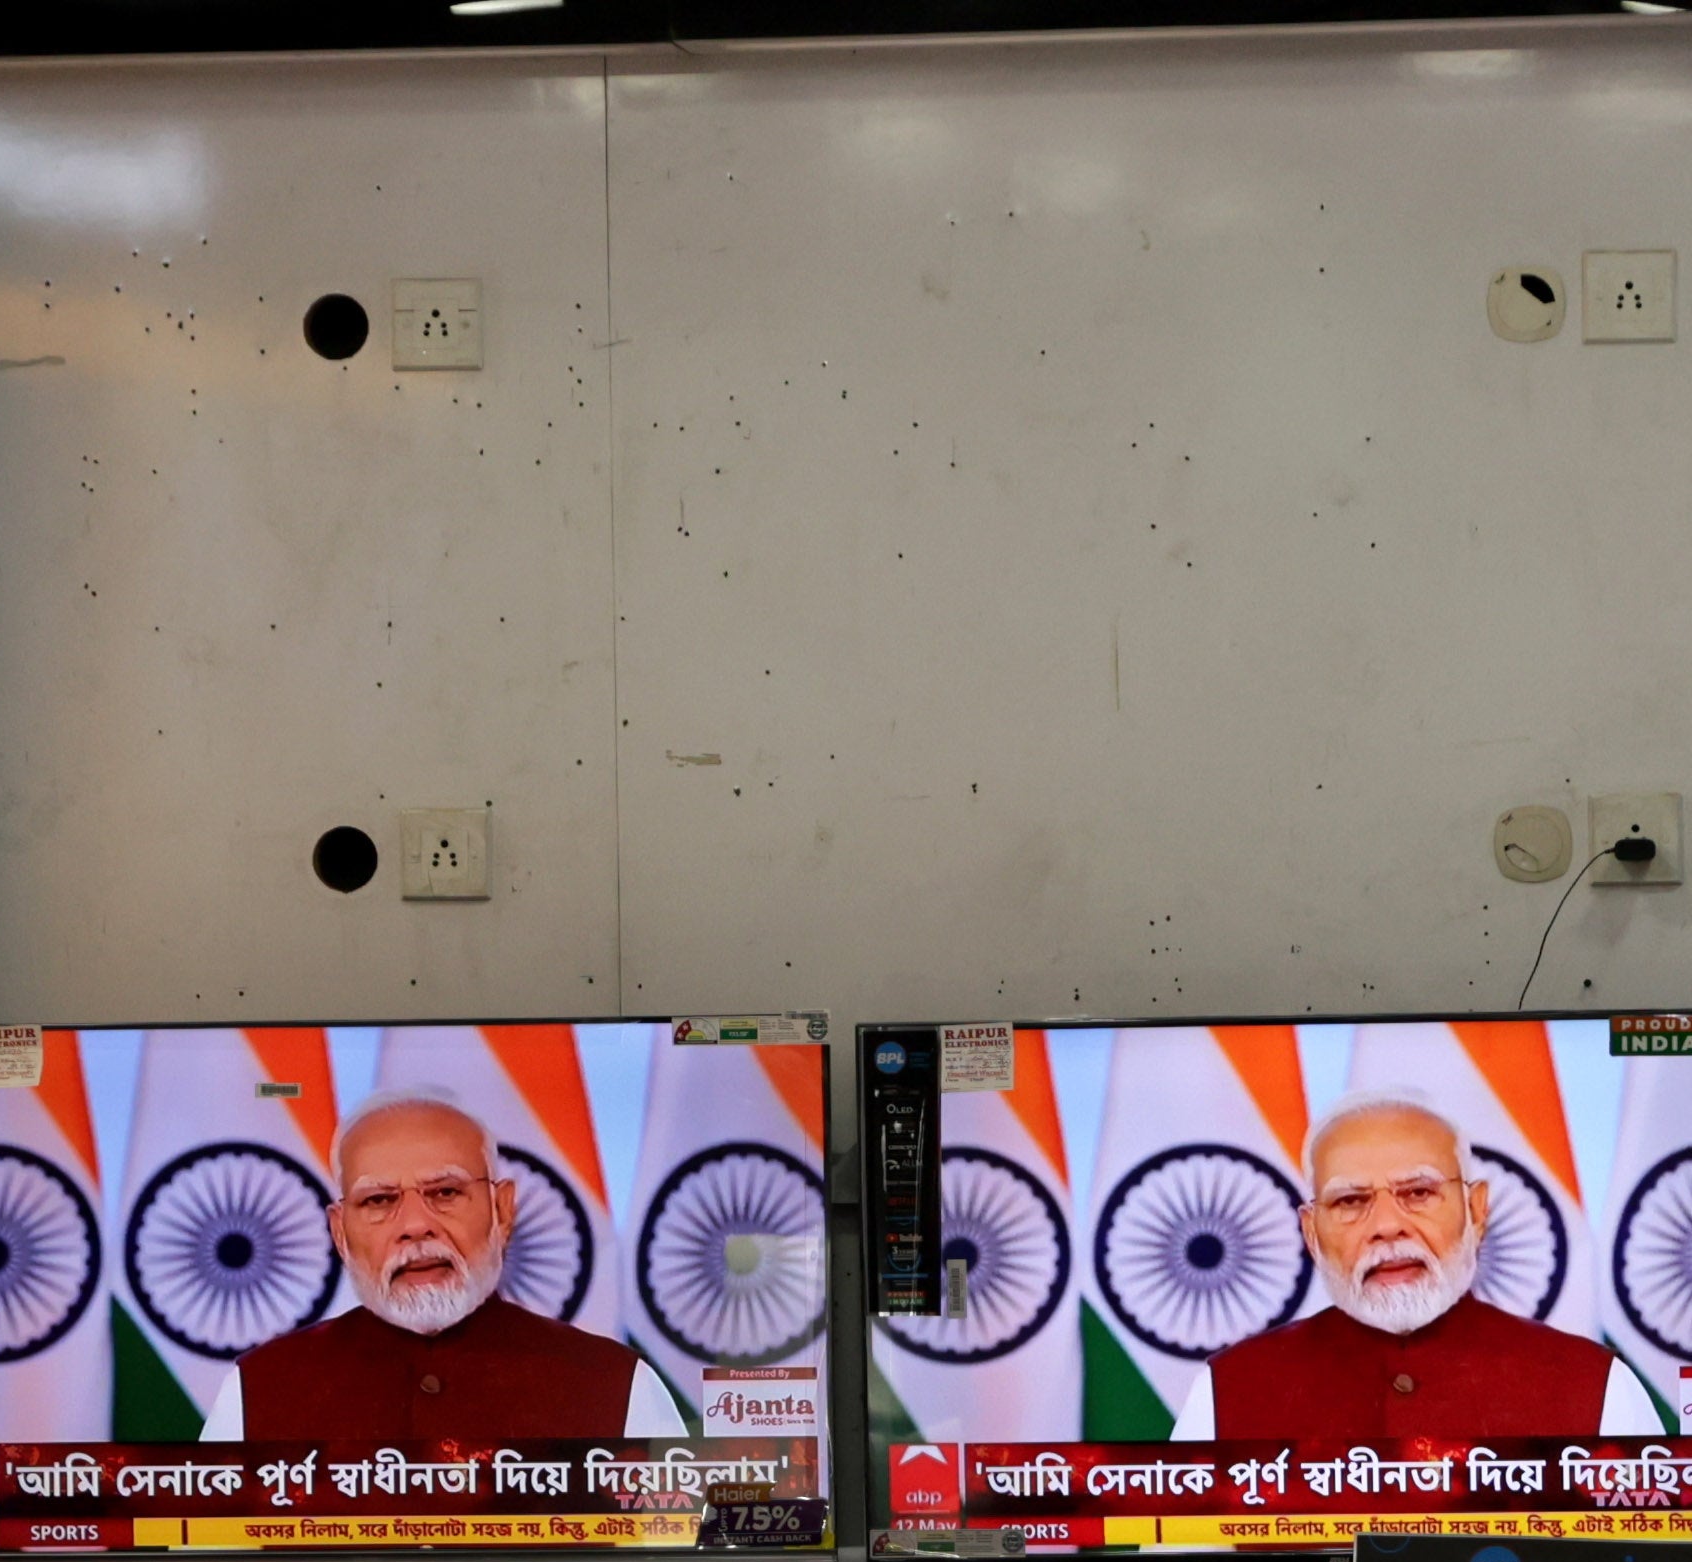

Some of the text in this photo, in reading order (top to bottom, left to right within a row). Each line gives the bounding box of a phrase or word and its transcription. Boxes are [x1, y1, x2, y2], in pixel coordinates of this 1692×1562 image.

[944, 1027, 1008, 1040] RAIPUR
[945, 1039, 1009, 1048] ELECTRONICS
[876, 1052, 905, 1064] BPL
[729, 1369, 791, 1379] Presented By
[706, 1390, 815, 1424] Ajanta
[750, 1416, 784, 1426] SHOES
[6, 1447, 572, 1507] 'আমি সেনাকে পূর্ণ স্বাধীনতা দিয়ে
[976, 1451, 1074, 1498] 'আমি
[1086, 1458, 1216, 1498] সেনাকে
[1228, 1448, 1291, 1506] পূর্ণ
[1300, 1446, 1453, 1496] স্বাধীনতা
[1466, 1445, 1546, 1495] দিয়ে
[615, 1494, 695, 1510] TATA
[714, 1487, 762, 1502] Haier
[905, 1488, 942, 1505] abp
[1590, 1490, 1672, 1507] TATA
[30, 1524, 99, 1541] SPORTS
[713, 1533, 812, 1546] INSTANT CASH BACK
